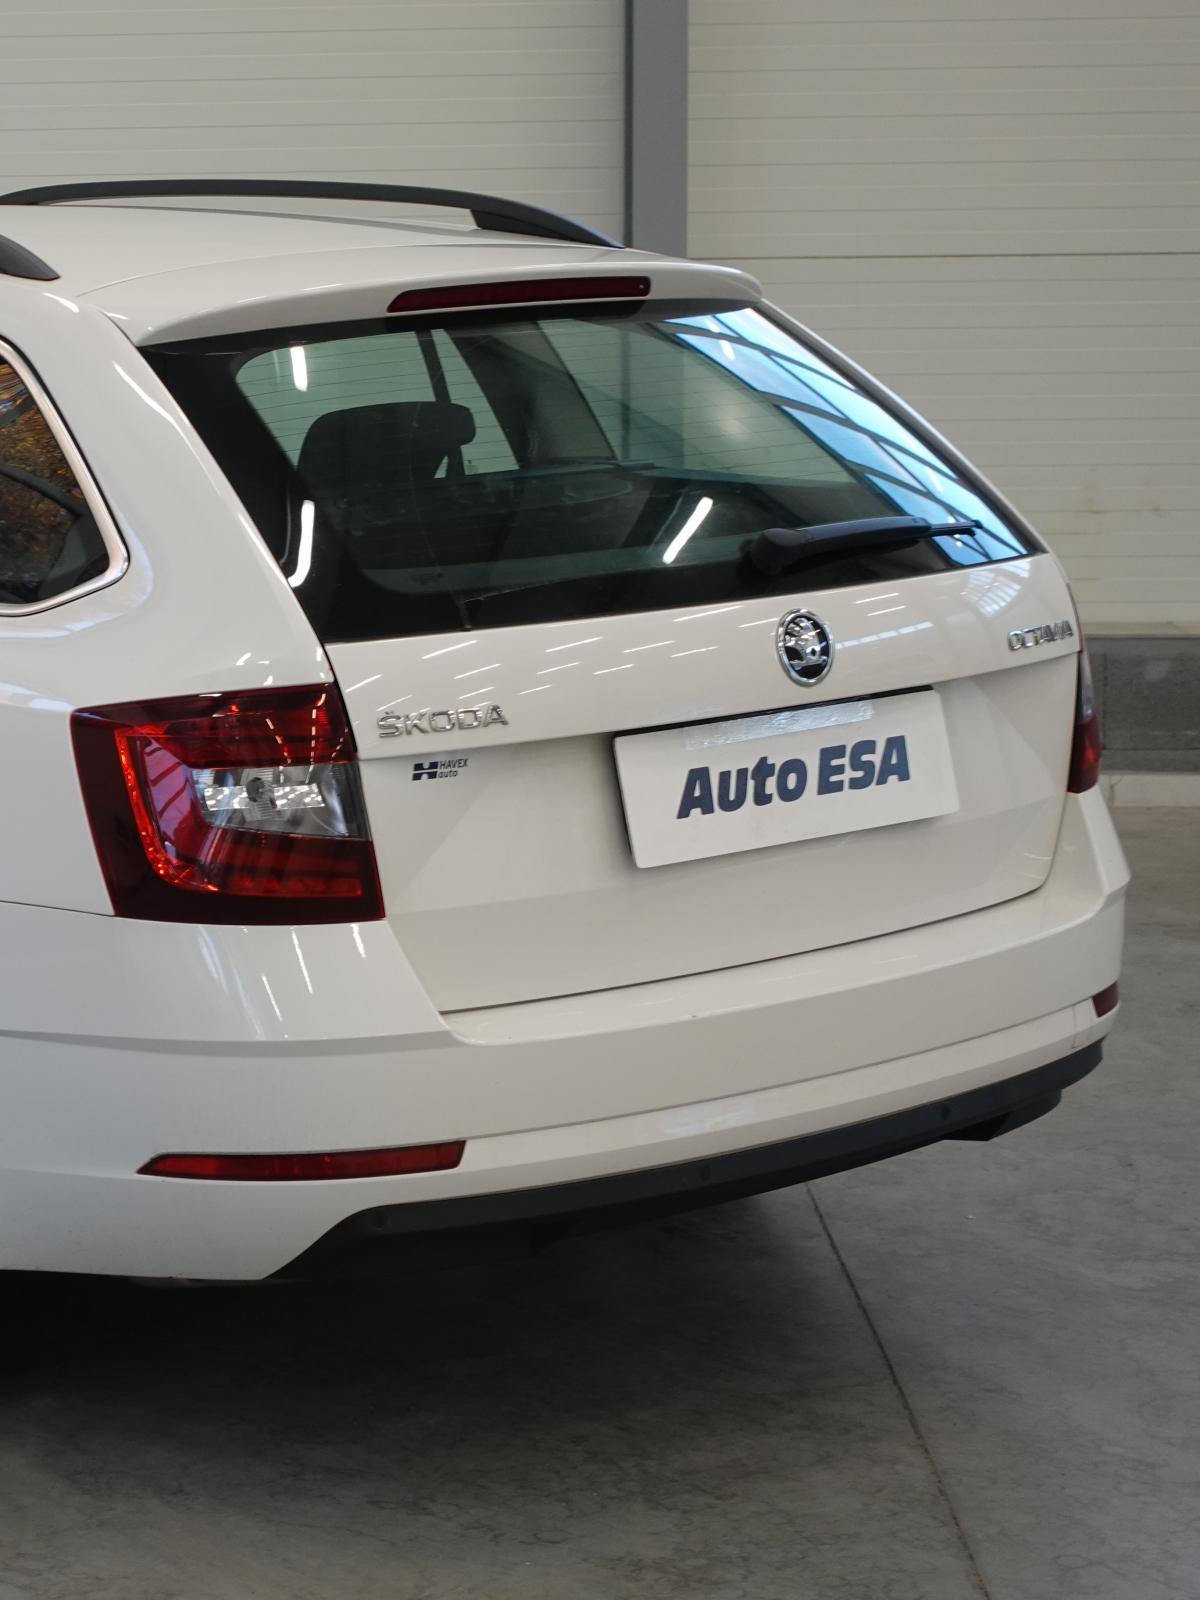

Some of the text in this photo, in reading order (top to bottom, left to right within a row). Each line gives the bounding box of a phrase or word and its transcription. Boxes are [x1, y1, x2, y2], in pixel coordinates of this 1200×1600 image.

[377, 704, 509, 738] ŠKODA
[438, 770, 458, 778] auto
[439, 758, 469, 769] HAVEX
[676, 735, 911, 819] Auto ESA
